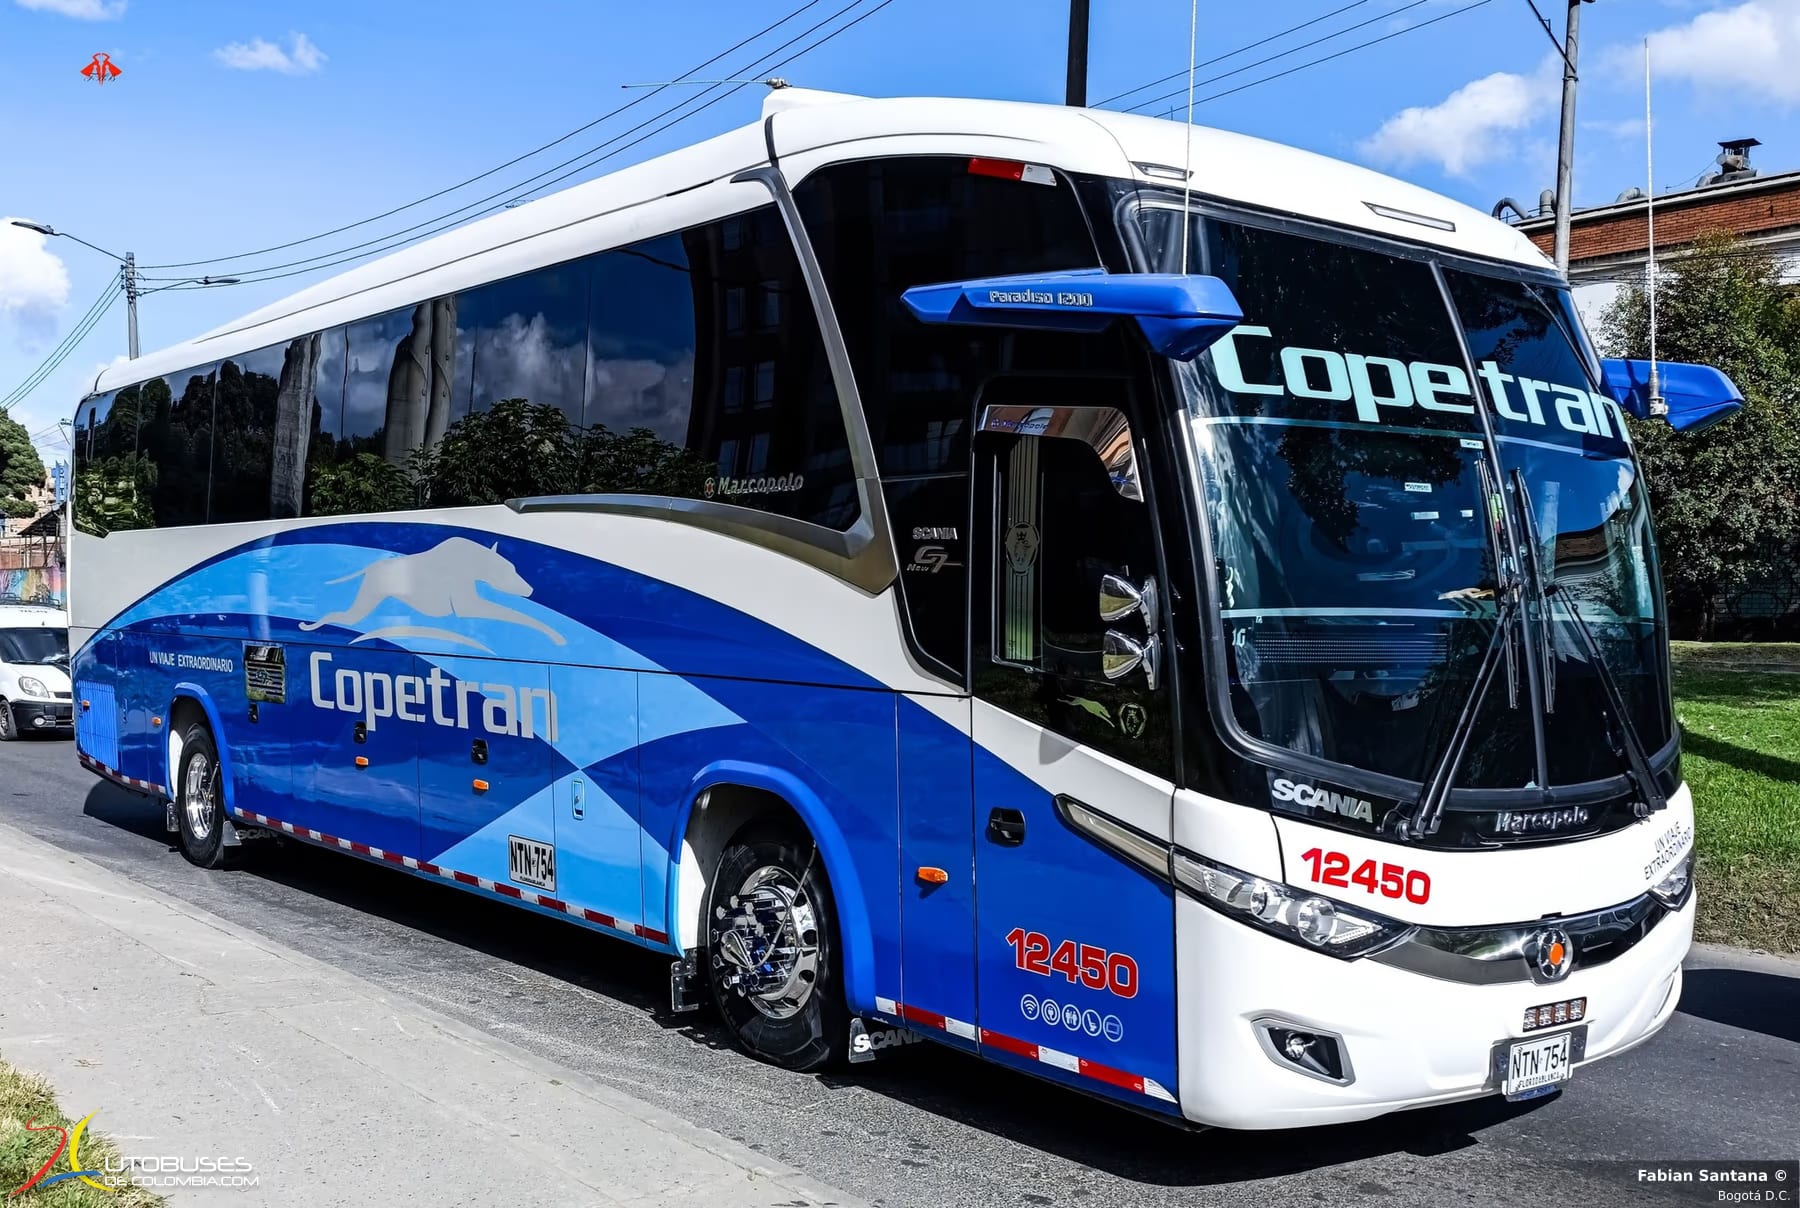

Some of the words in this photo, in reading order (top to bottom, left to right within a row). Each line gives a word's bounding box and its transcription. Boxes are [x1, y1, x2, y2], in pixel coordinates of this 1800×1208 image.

[989, 289, 1053, 304] Paradiso
[1058, 292, 1094, 307] 1200
[1210, 325, 1634, 444] Copetran
[717, 472, 804, 495] Marcopolo
[912, 527, 958, 540] SCANIA
[906, 563, 930, 572] New
[149, 651, 158, 664] UN
[159, 652, 175, 666] VIAJE
[177, 654, 234, 673] EXTRAORDINARIO
[310, 651, 559, 742] Copetran
[1272, 778, 1373, 823] SCANIA
[1495, 805, 1588, 832] Marcopolo
[1301, 847, 1431, 905] 12450
[1005, 927, 1139, 999] 12450
